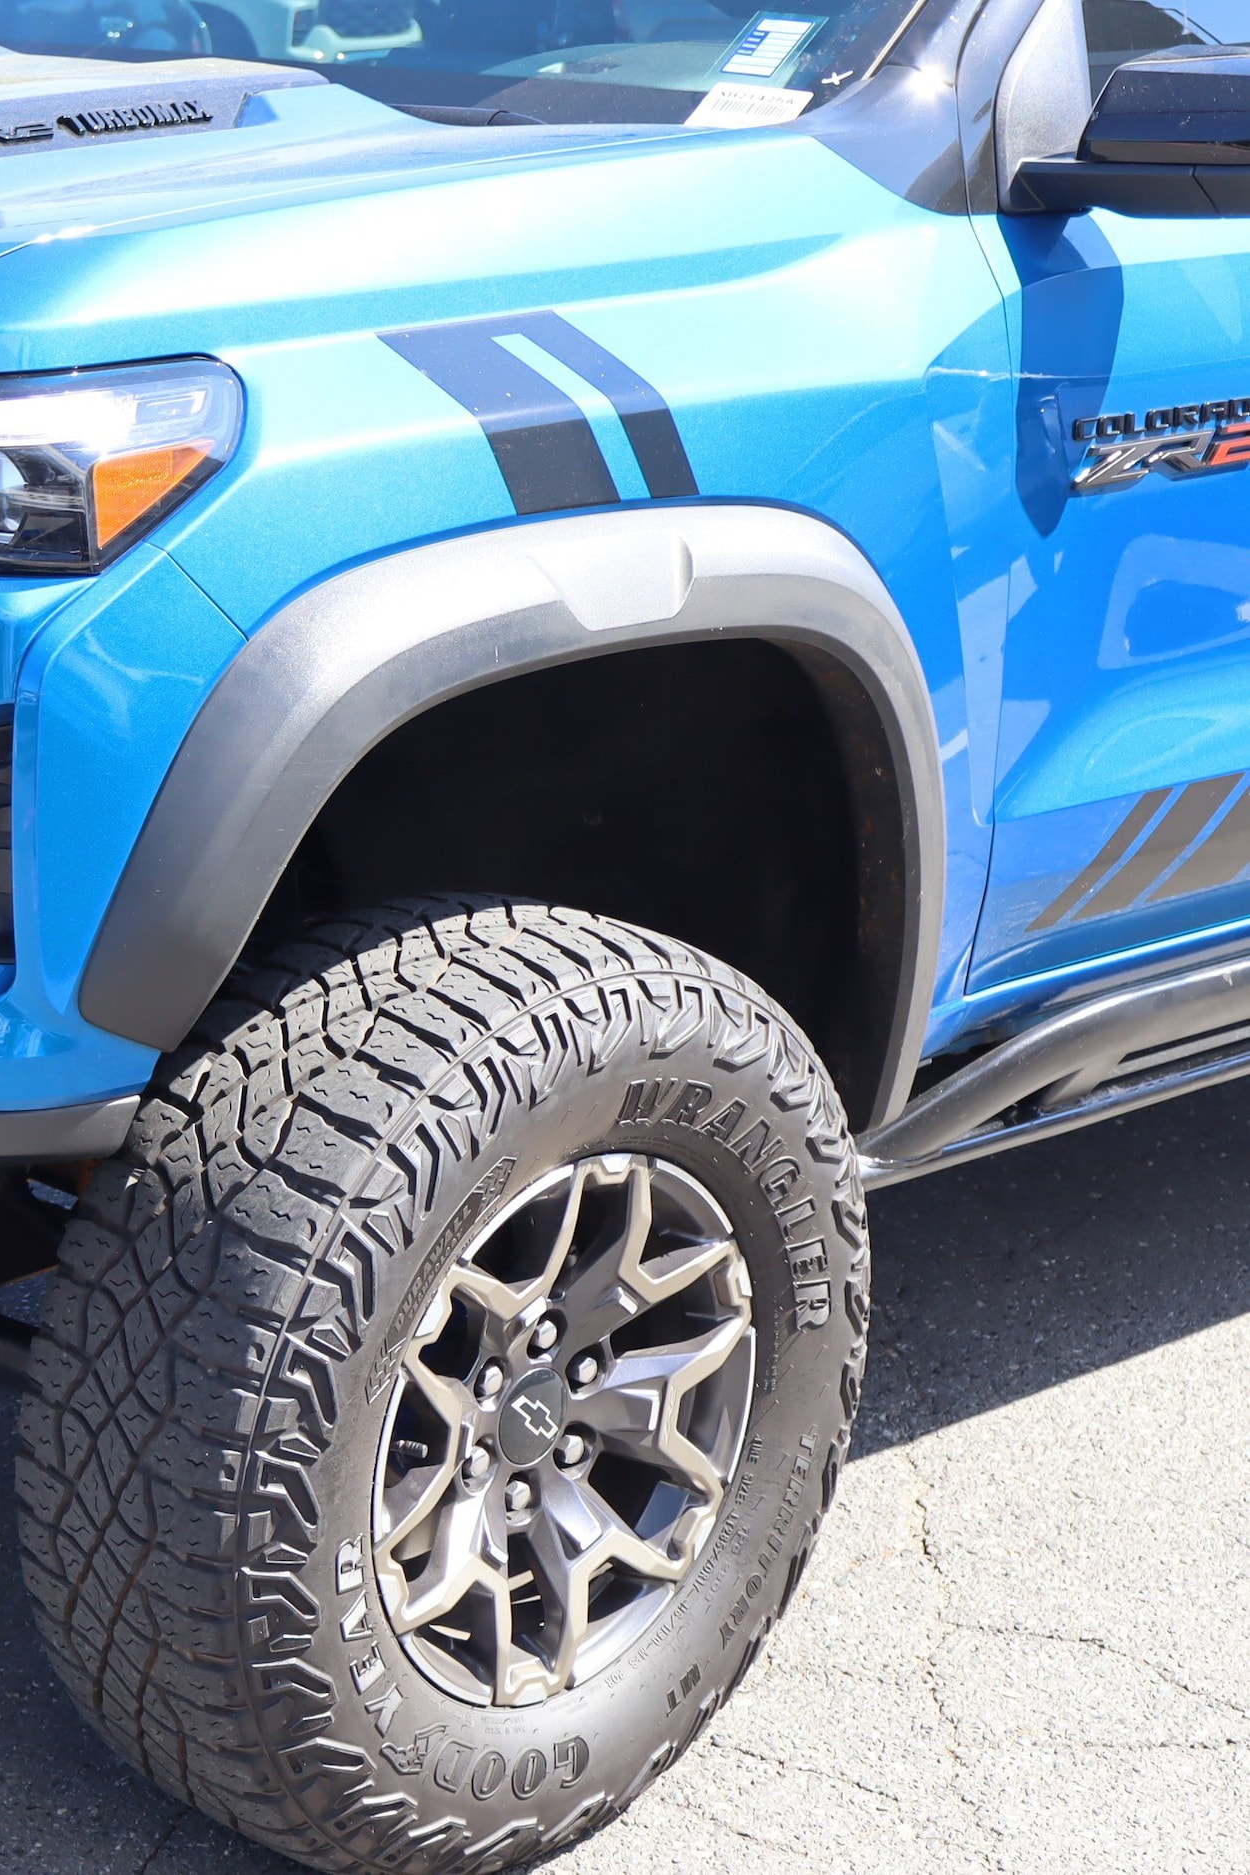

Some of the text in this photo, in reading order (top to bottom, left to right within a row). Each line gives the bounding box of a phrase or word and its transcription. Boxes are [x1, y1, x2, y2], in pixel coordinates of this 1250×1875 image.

[56, 100, 213, 136] TURBOMAX
[393, 1203, 472, 1333] DURAWALL
[615, 1077, 832, 1332] WRANGLER
[336, 1533, 591, 1801] GOODYEAR
[666, 1431, 818, 1717] TERRITORY MT
